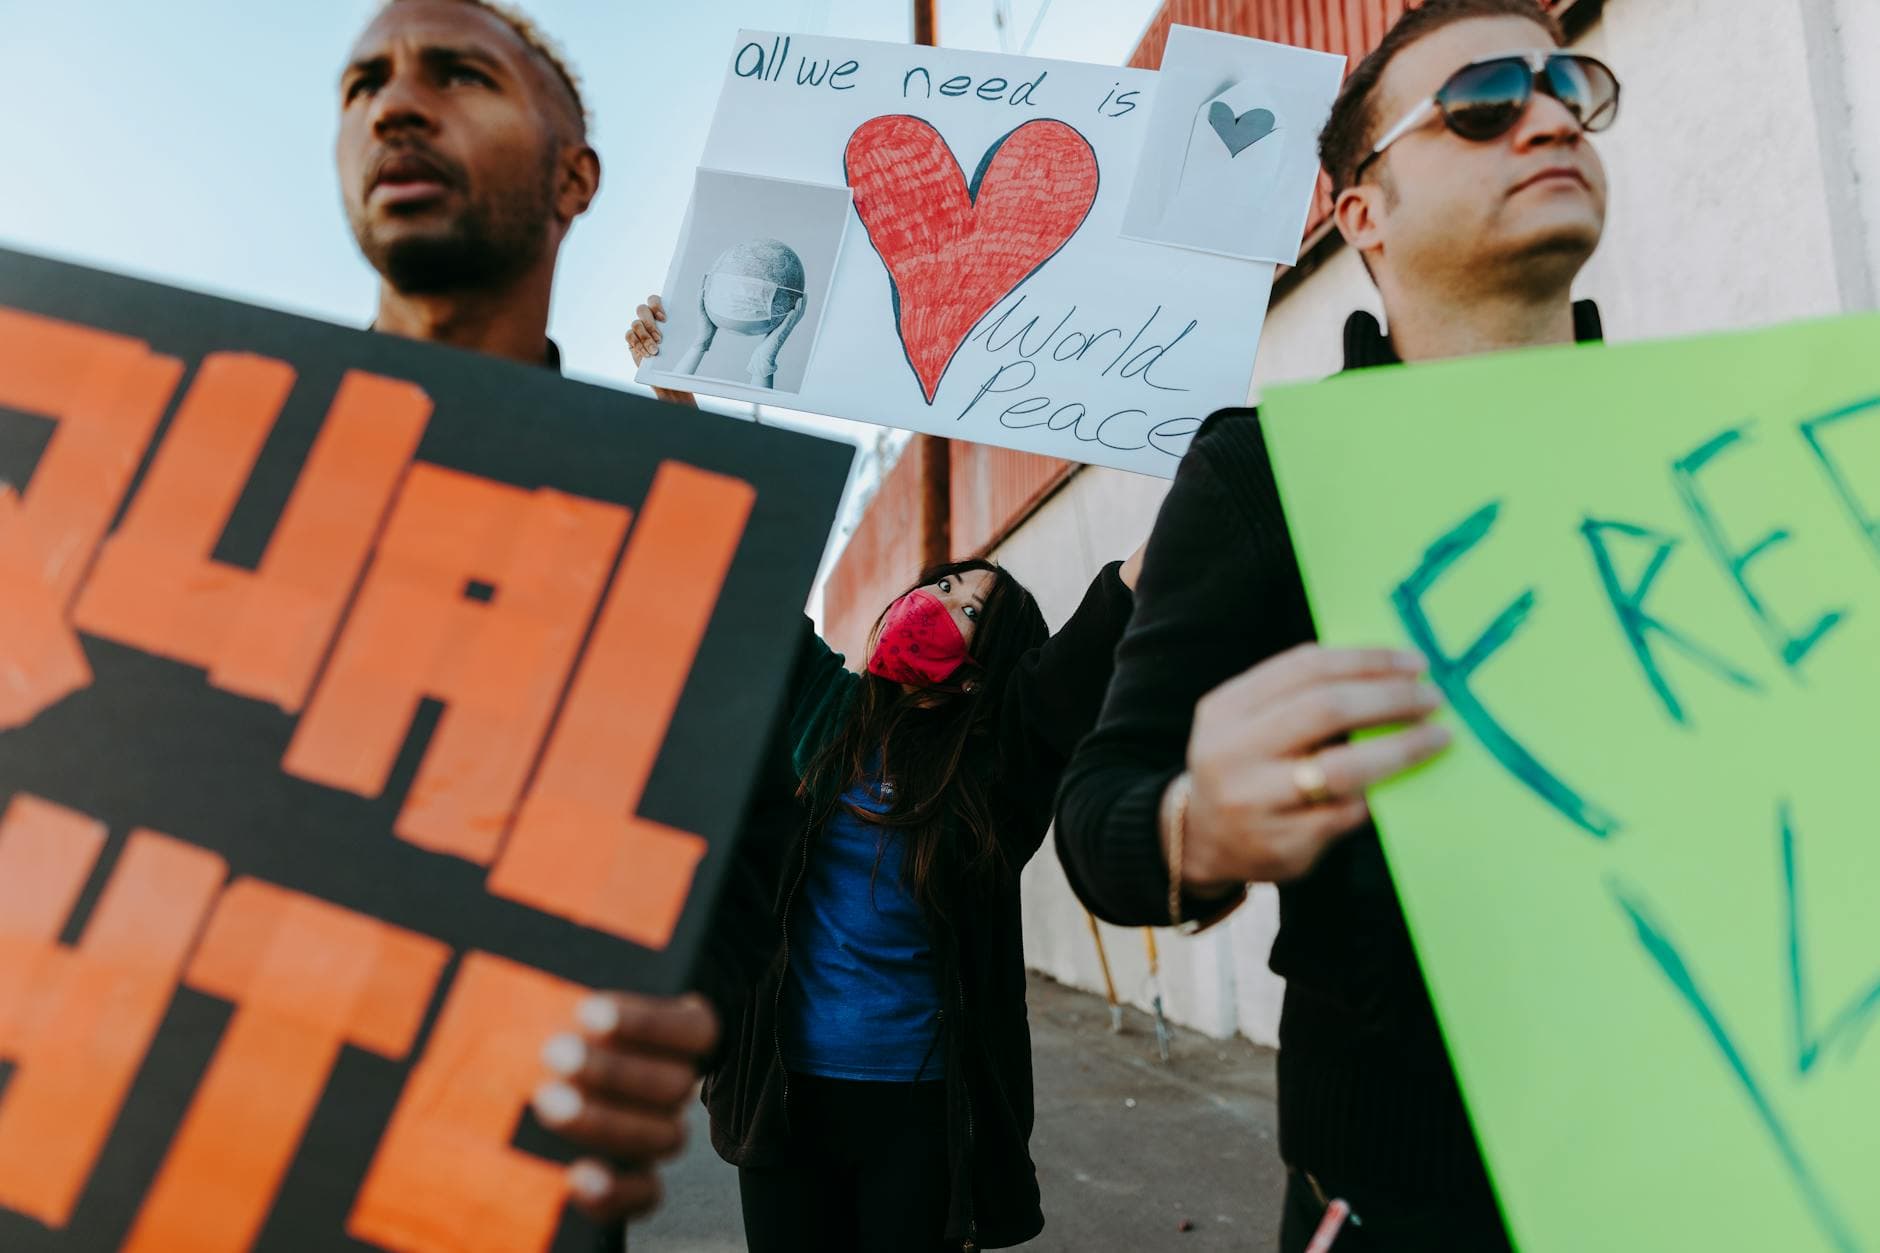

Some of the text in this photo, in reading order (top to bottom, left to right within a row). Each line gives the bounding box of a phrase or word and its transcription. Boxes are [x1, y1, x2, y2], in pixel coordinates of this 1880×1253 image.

[735, 36, 1140, 117] all we need is
[972, 294, 1198, 392] World
[956, 360, 1204, 458] Peace
